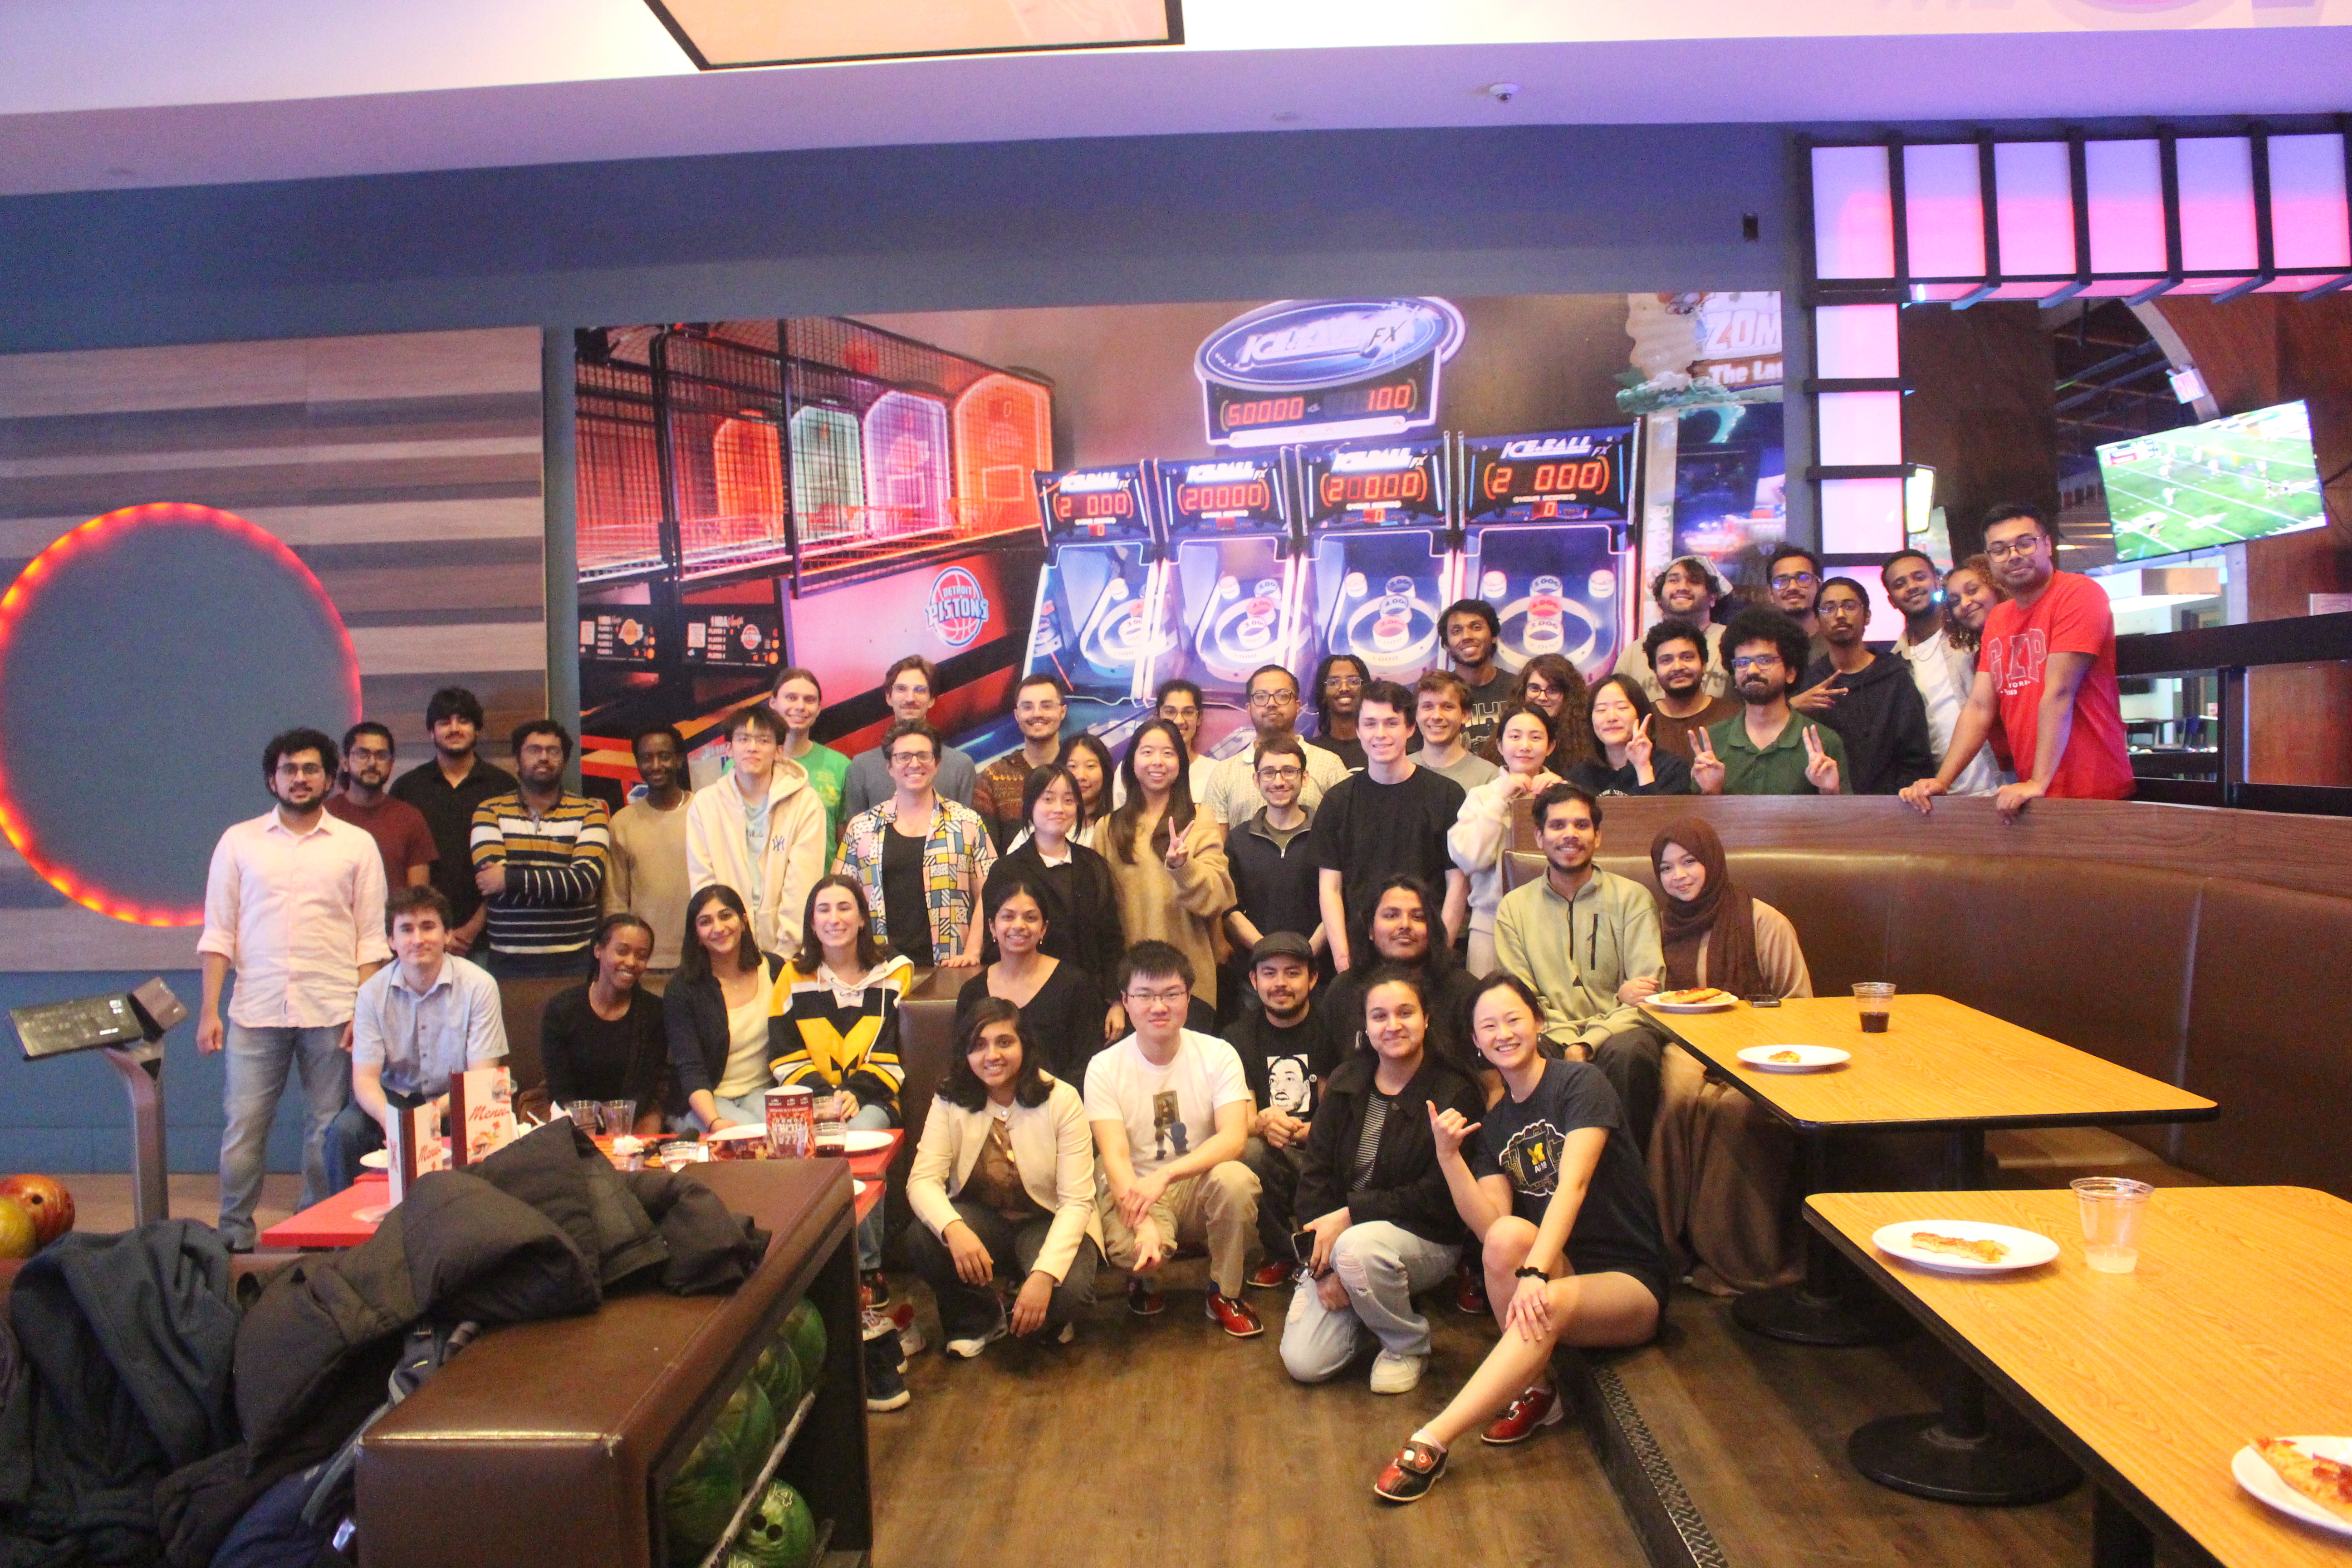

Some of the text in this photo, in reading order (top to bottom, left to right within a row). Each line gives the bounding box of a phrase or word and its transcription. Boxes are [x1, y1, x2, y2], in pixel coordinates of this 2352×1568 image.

[1710, 363, 1747, 385] The
[1228, 385, 1411, 427] 50000 100
[1185, 483, 1263, 510] 20000
[1327, 472, 1421, 501] 20000
[943, 585, 972, 598] DETROIT
[925, 598, 988, 627] PISTONS
[468, 1105, 510, 1122] Menu
[418, 1144, 441, 1163] Menu
